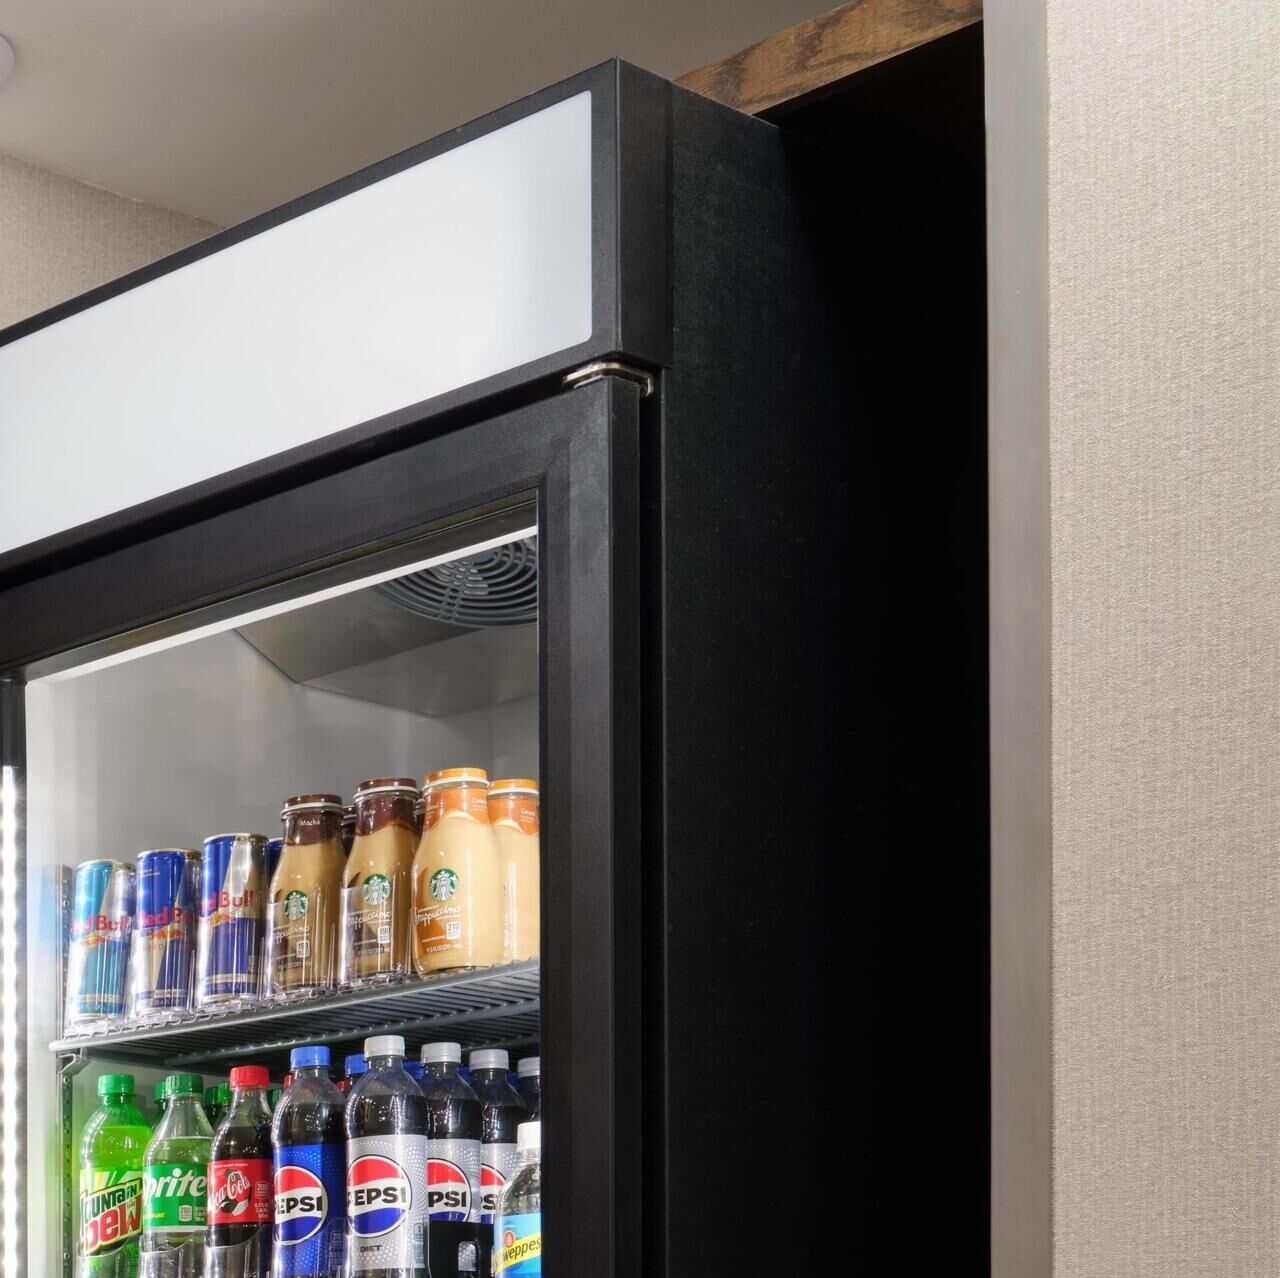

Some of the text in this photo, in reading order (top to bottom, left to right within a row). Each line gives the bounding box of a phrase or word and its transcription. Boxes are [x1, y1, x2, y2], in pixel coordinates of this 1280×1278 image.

[299, 818, 321, 827] Mocha
[218, 889, 254, 909] Bull
[95, 914, 129, 932] Bull
[429, 1190, 467, 1209] PSI
